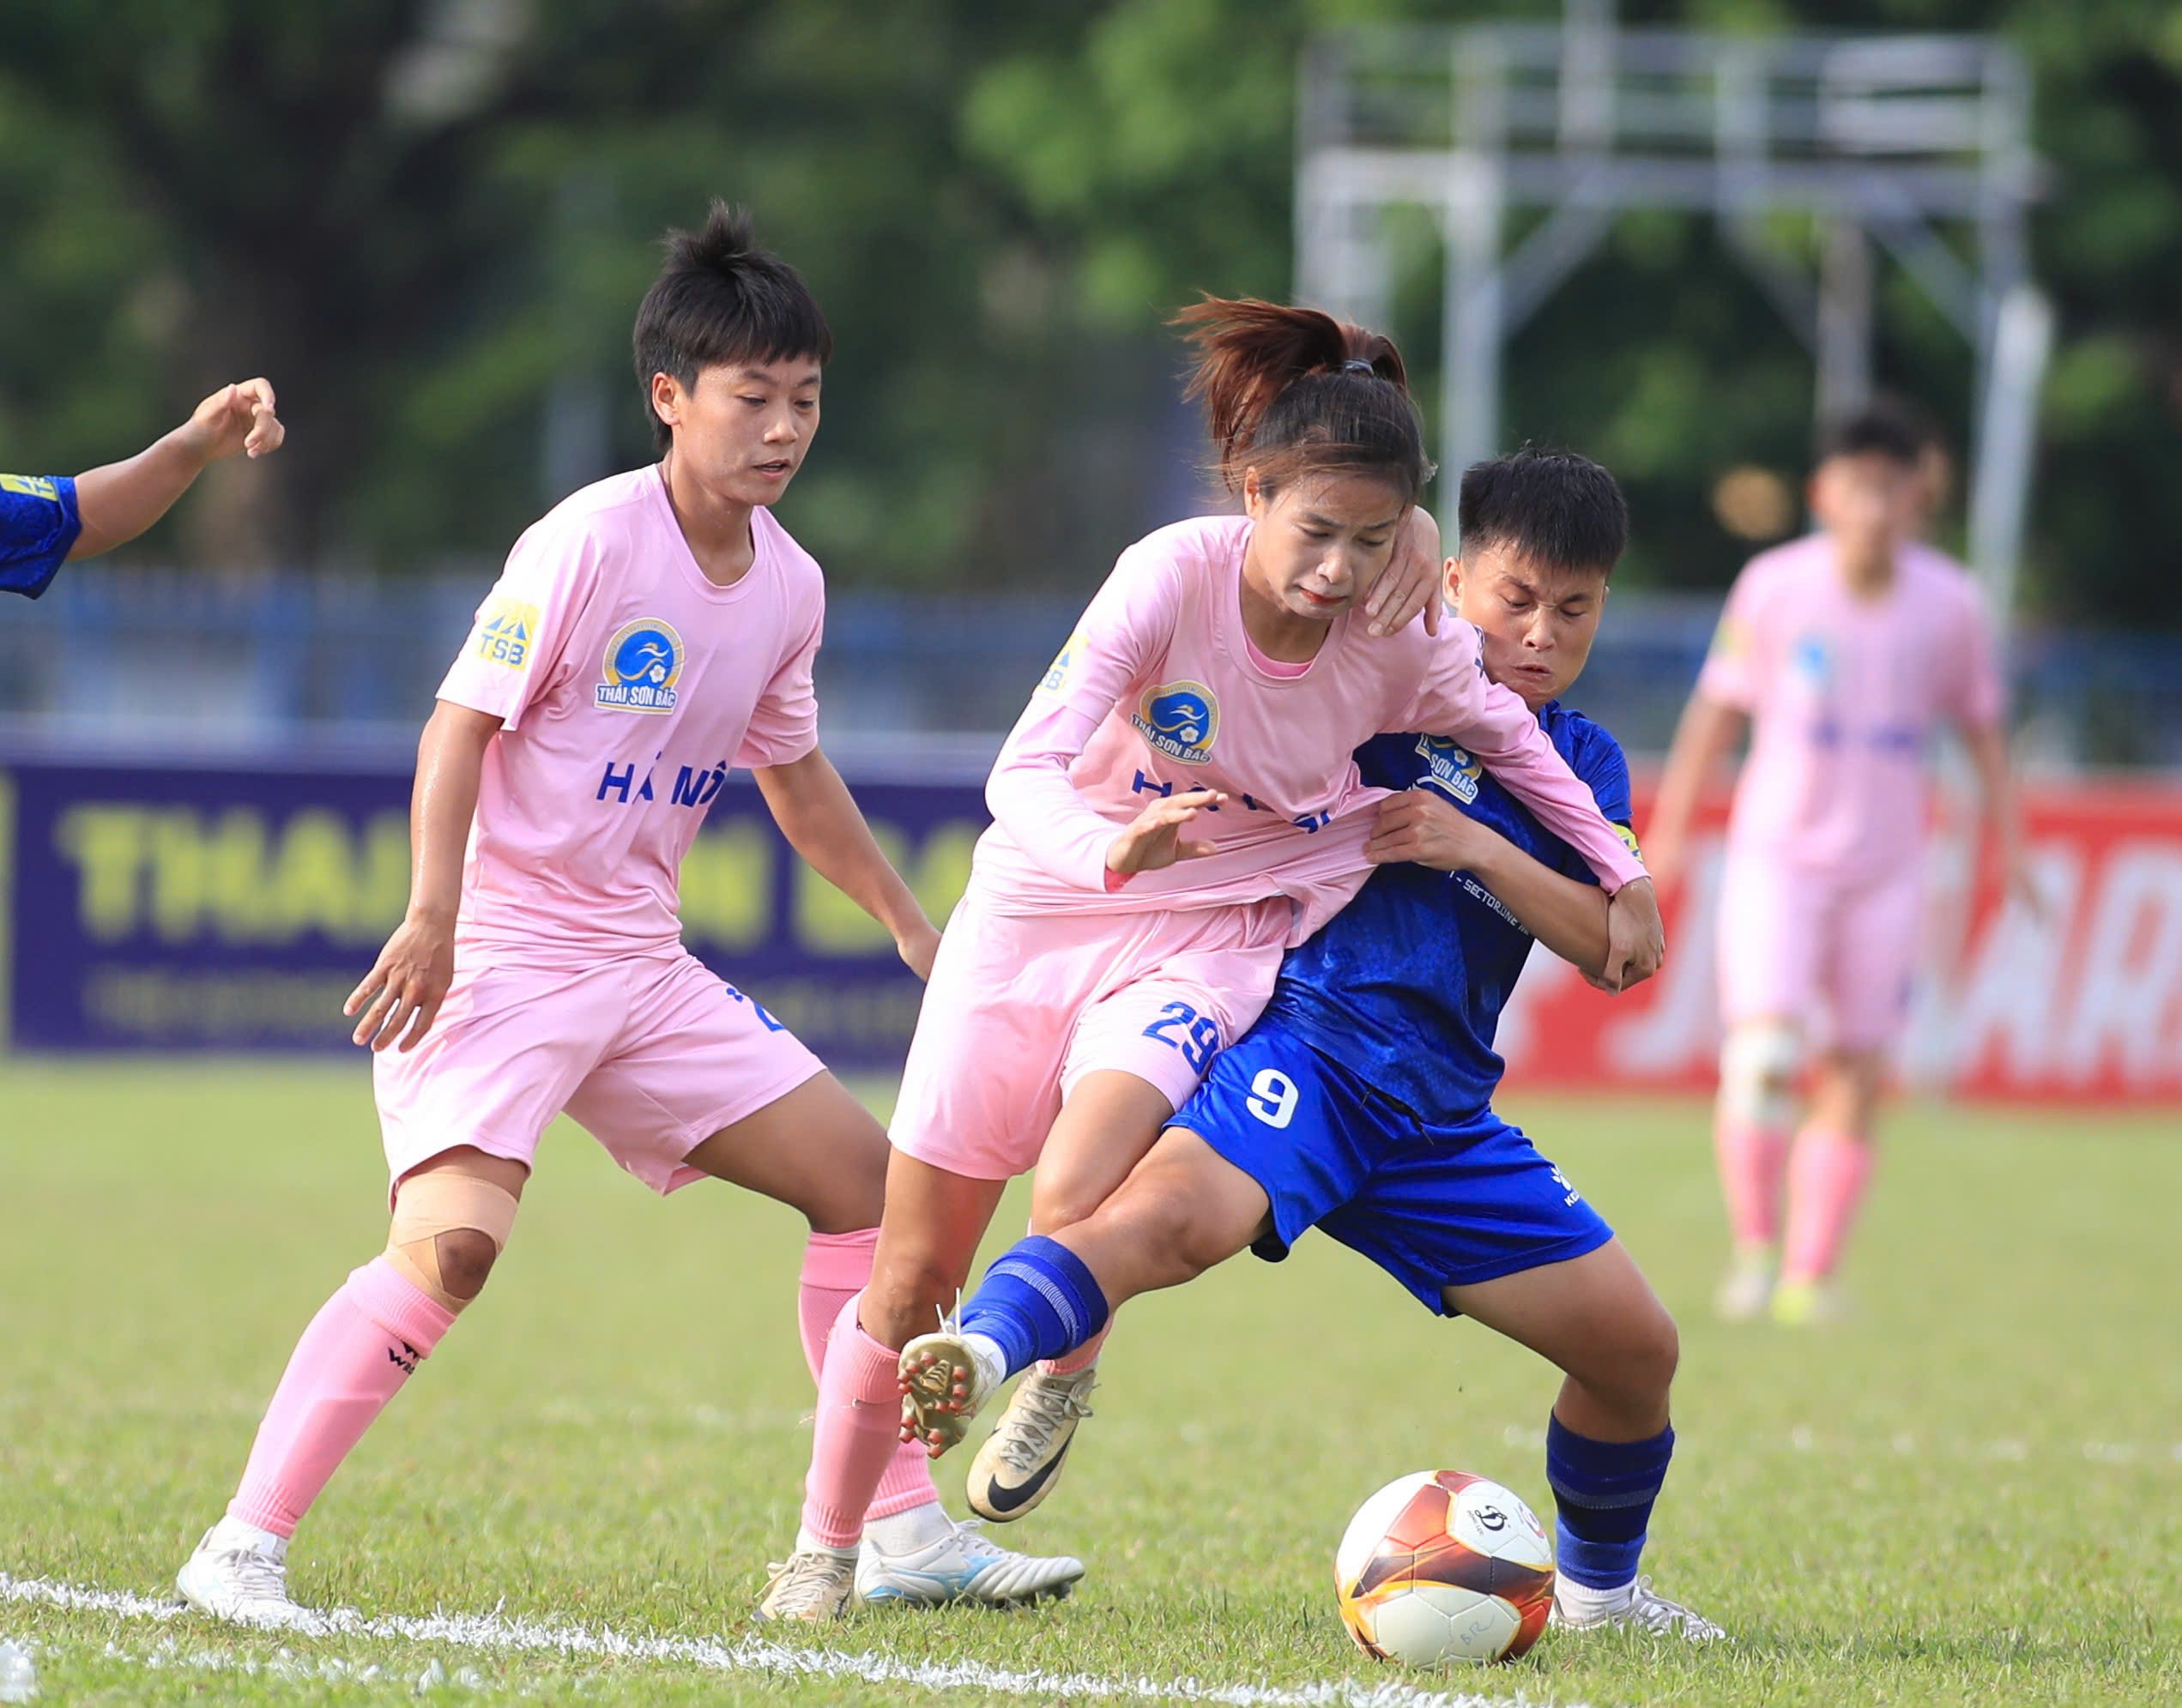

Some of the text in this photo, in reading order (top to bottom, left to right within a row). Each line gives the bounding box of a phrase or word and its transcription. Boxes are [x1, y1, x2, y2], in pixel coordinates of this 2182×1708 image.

[481, 633, 525, 666] TSB
[598, 684, 628, 703] THÁI
[629, 685, 655, 705] SƠN
[1133, 715, 1156, 740] THÁI
[1156, 734, 1182, 756] SƠN
[1430, 753, 1454, 780] SƠN
[1142, 1001, 1219, 1076] 29
[1246, 1068, 1299, 1130] 9
